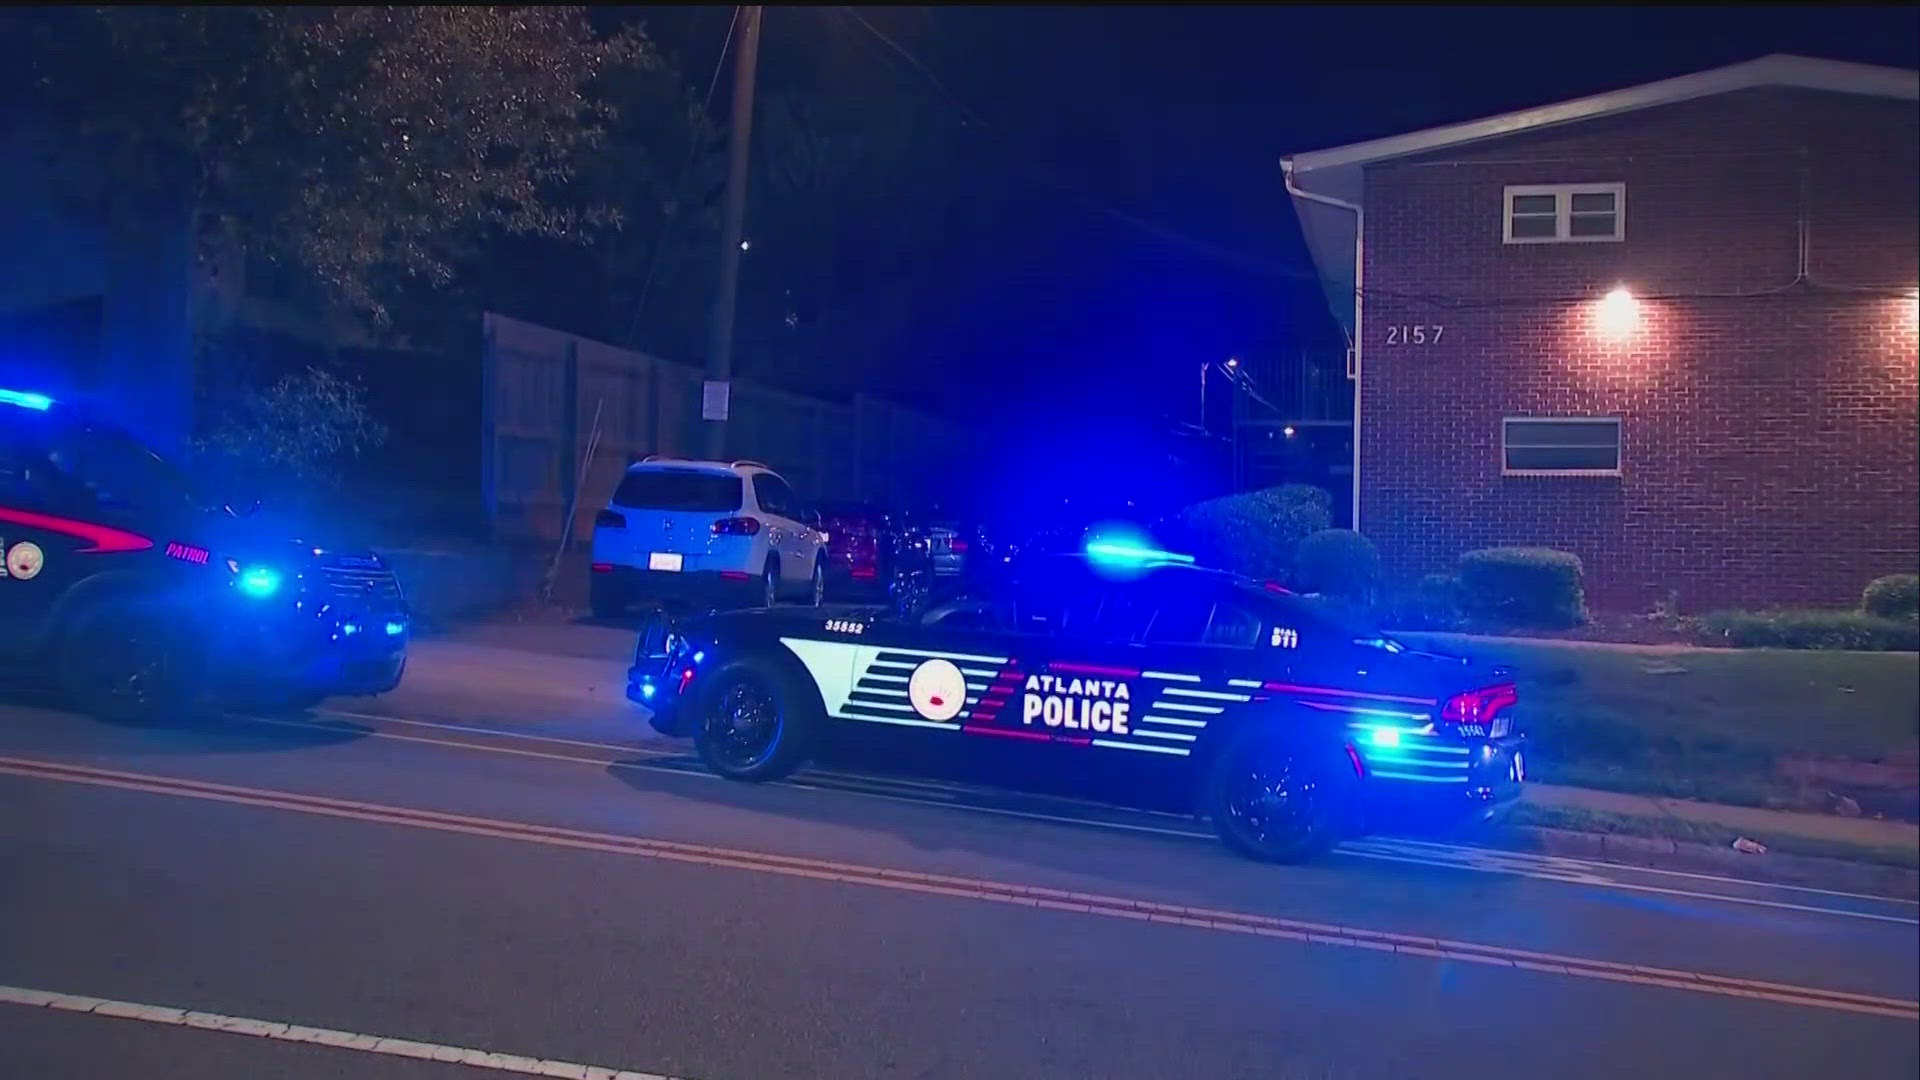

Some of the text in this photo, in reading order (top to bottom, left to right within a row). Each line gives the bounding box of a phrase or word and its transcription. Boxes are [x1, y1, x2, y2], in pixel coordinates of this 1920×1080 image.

[1386, 325, 1444, 344] 2157
[165, 543, 210, 565] PATROL
[1271, 634, 1298, 649] 911
[1025, 674, 1130, 700] ATLANTA
[1023, 693, 1130, 734] POLICE
